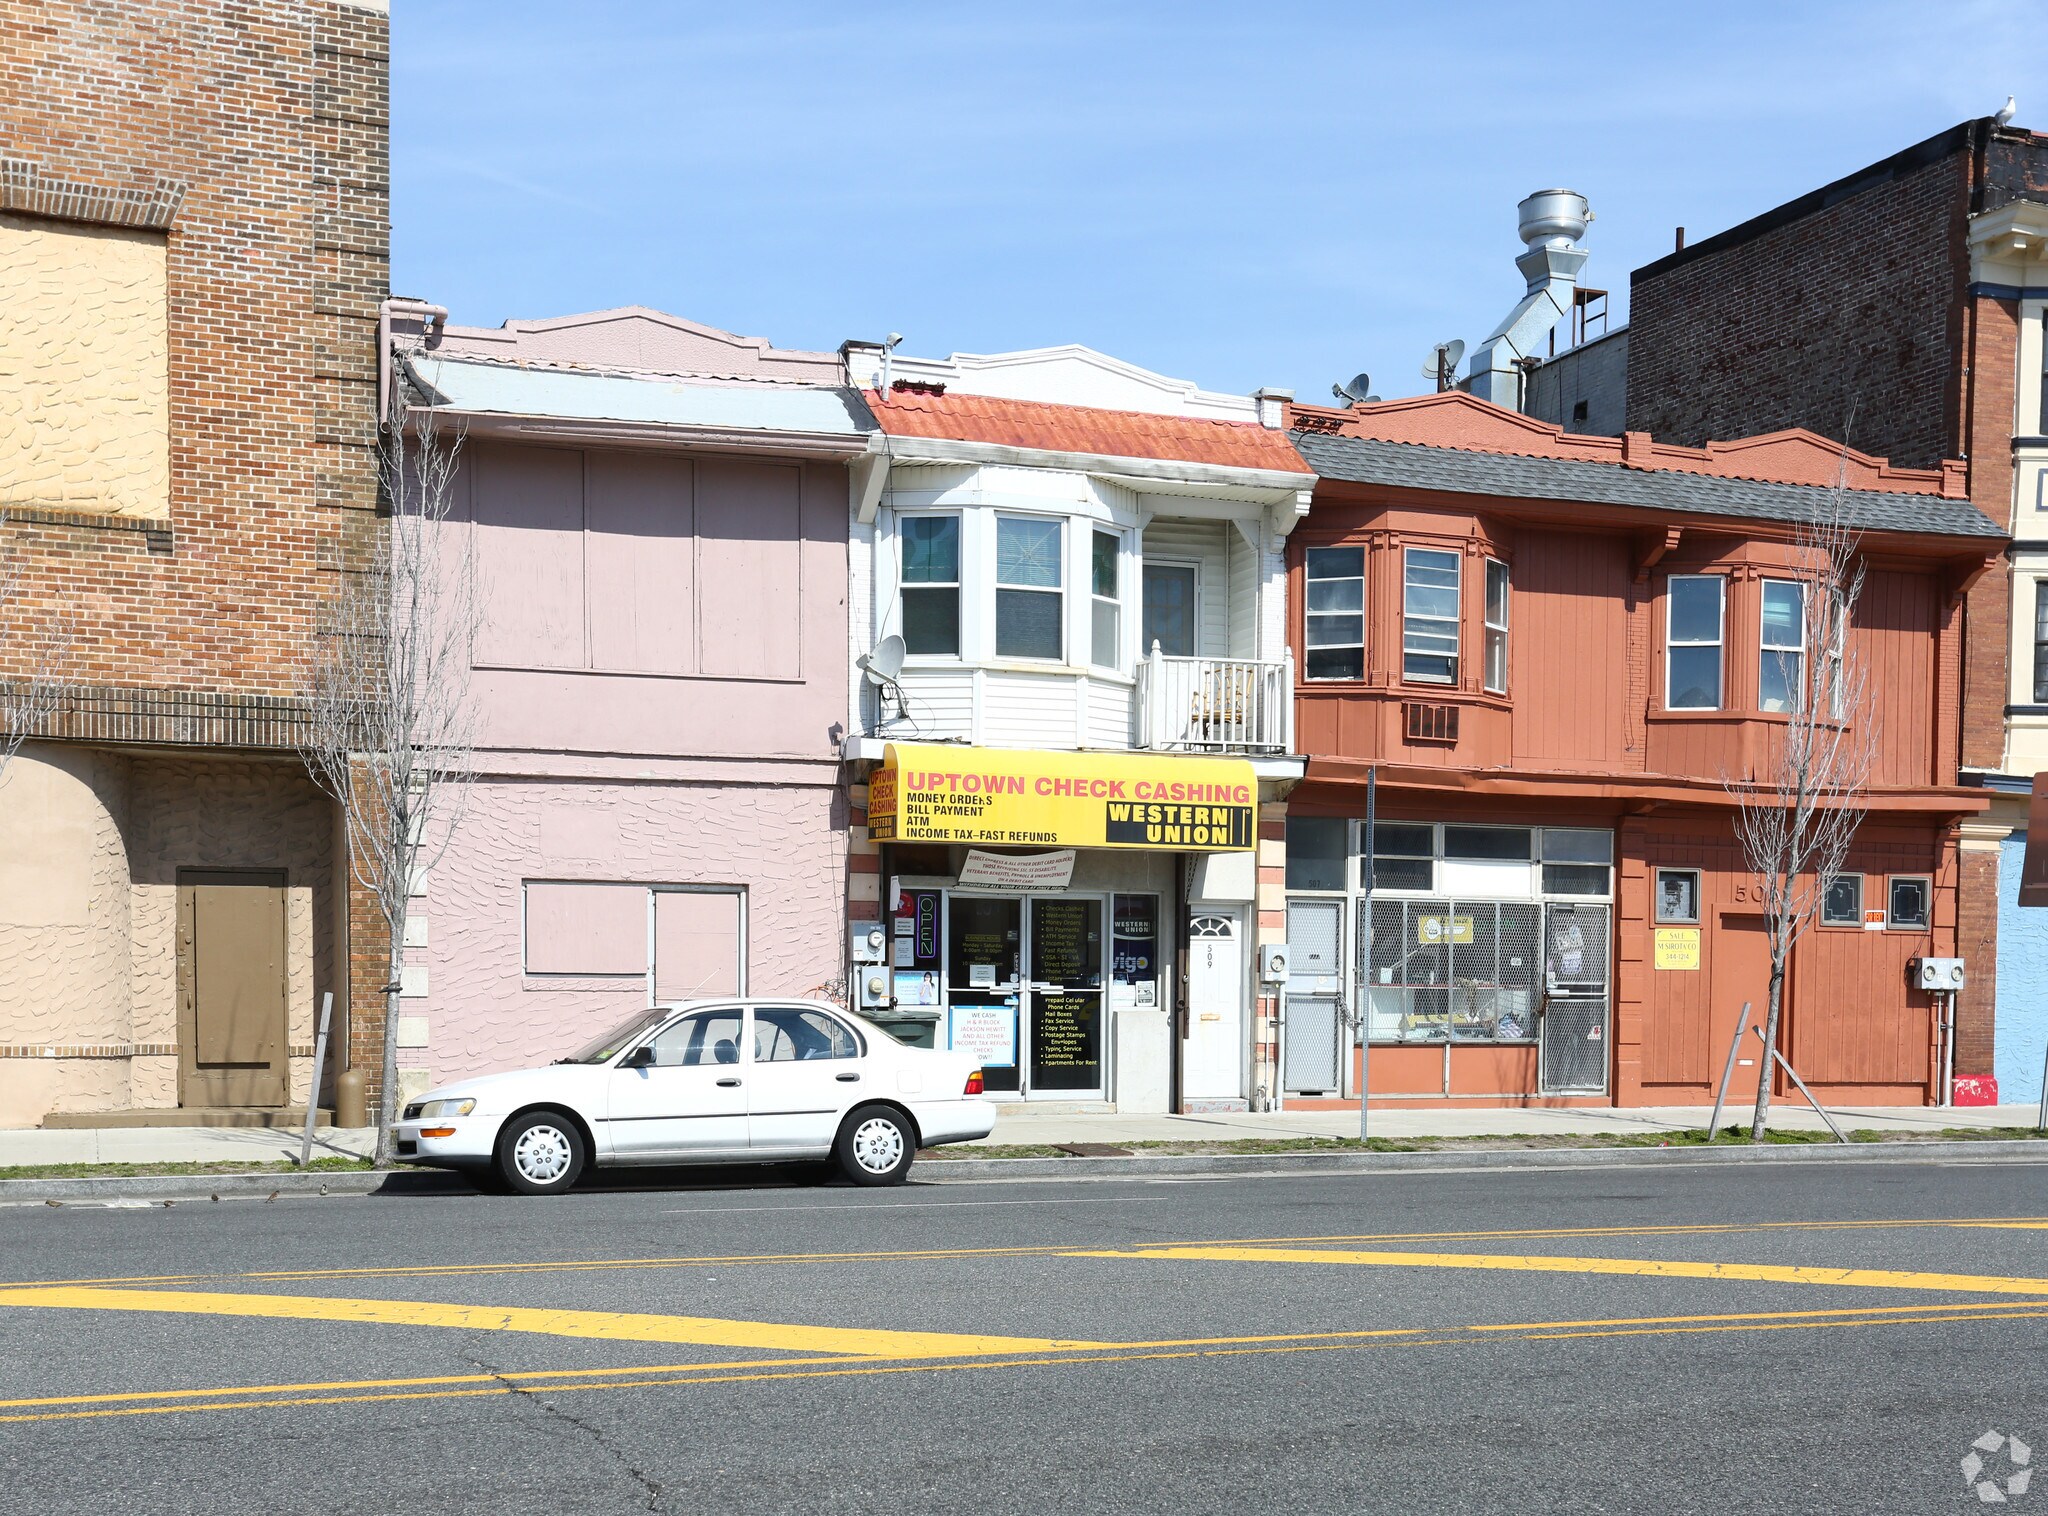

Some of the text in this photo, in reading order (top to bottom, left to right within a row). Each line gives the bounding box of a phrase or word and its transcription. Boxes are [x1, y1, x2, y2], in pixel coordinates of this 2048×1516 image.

[870, 768, 896, 785] UPTOWN
[873, 784, 894, 800] CHECK
[907, 772, 1250, 804] UPTOWN CHECK CASHING
[907, 792, 946, 804] MONEY
[869, 798, 896, 815] CASHING
[907, 804, 984, 816] BILL PAYMENT
[906, 816, 930, 826] ATM
[1108, 804, 1228, 826] WESTERN
[906, 828, 950, 839] INCOME
[1008, 831, 1058, 842] REFUNDS
[1146, 824, 1228, 844] UNION
[1308, 880, 1320, 888] 507
[1874, 912, 1884, 922] RENT
[920, 898, 933, 954] OPEN
[1113, 952, 1148, 973] vigo
